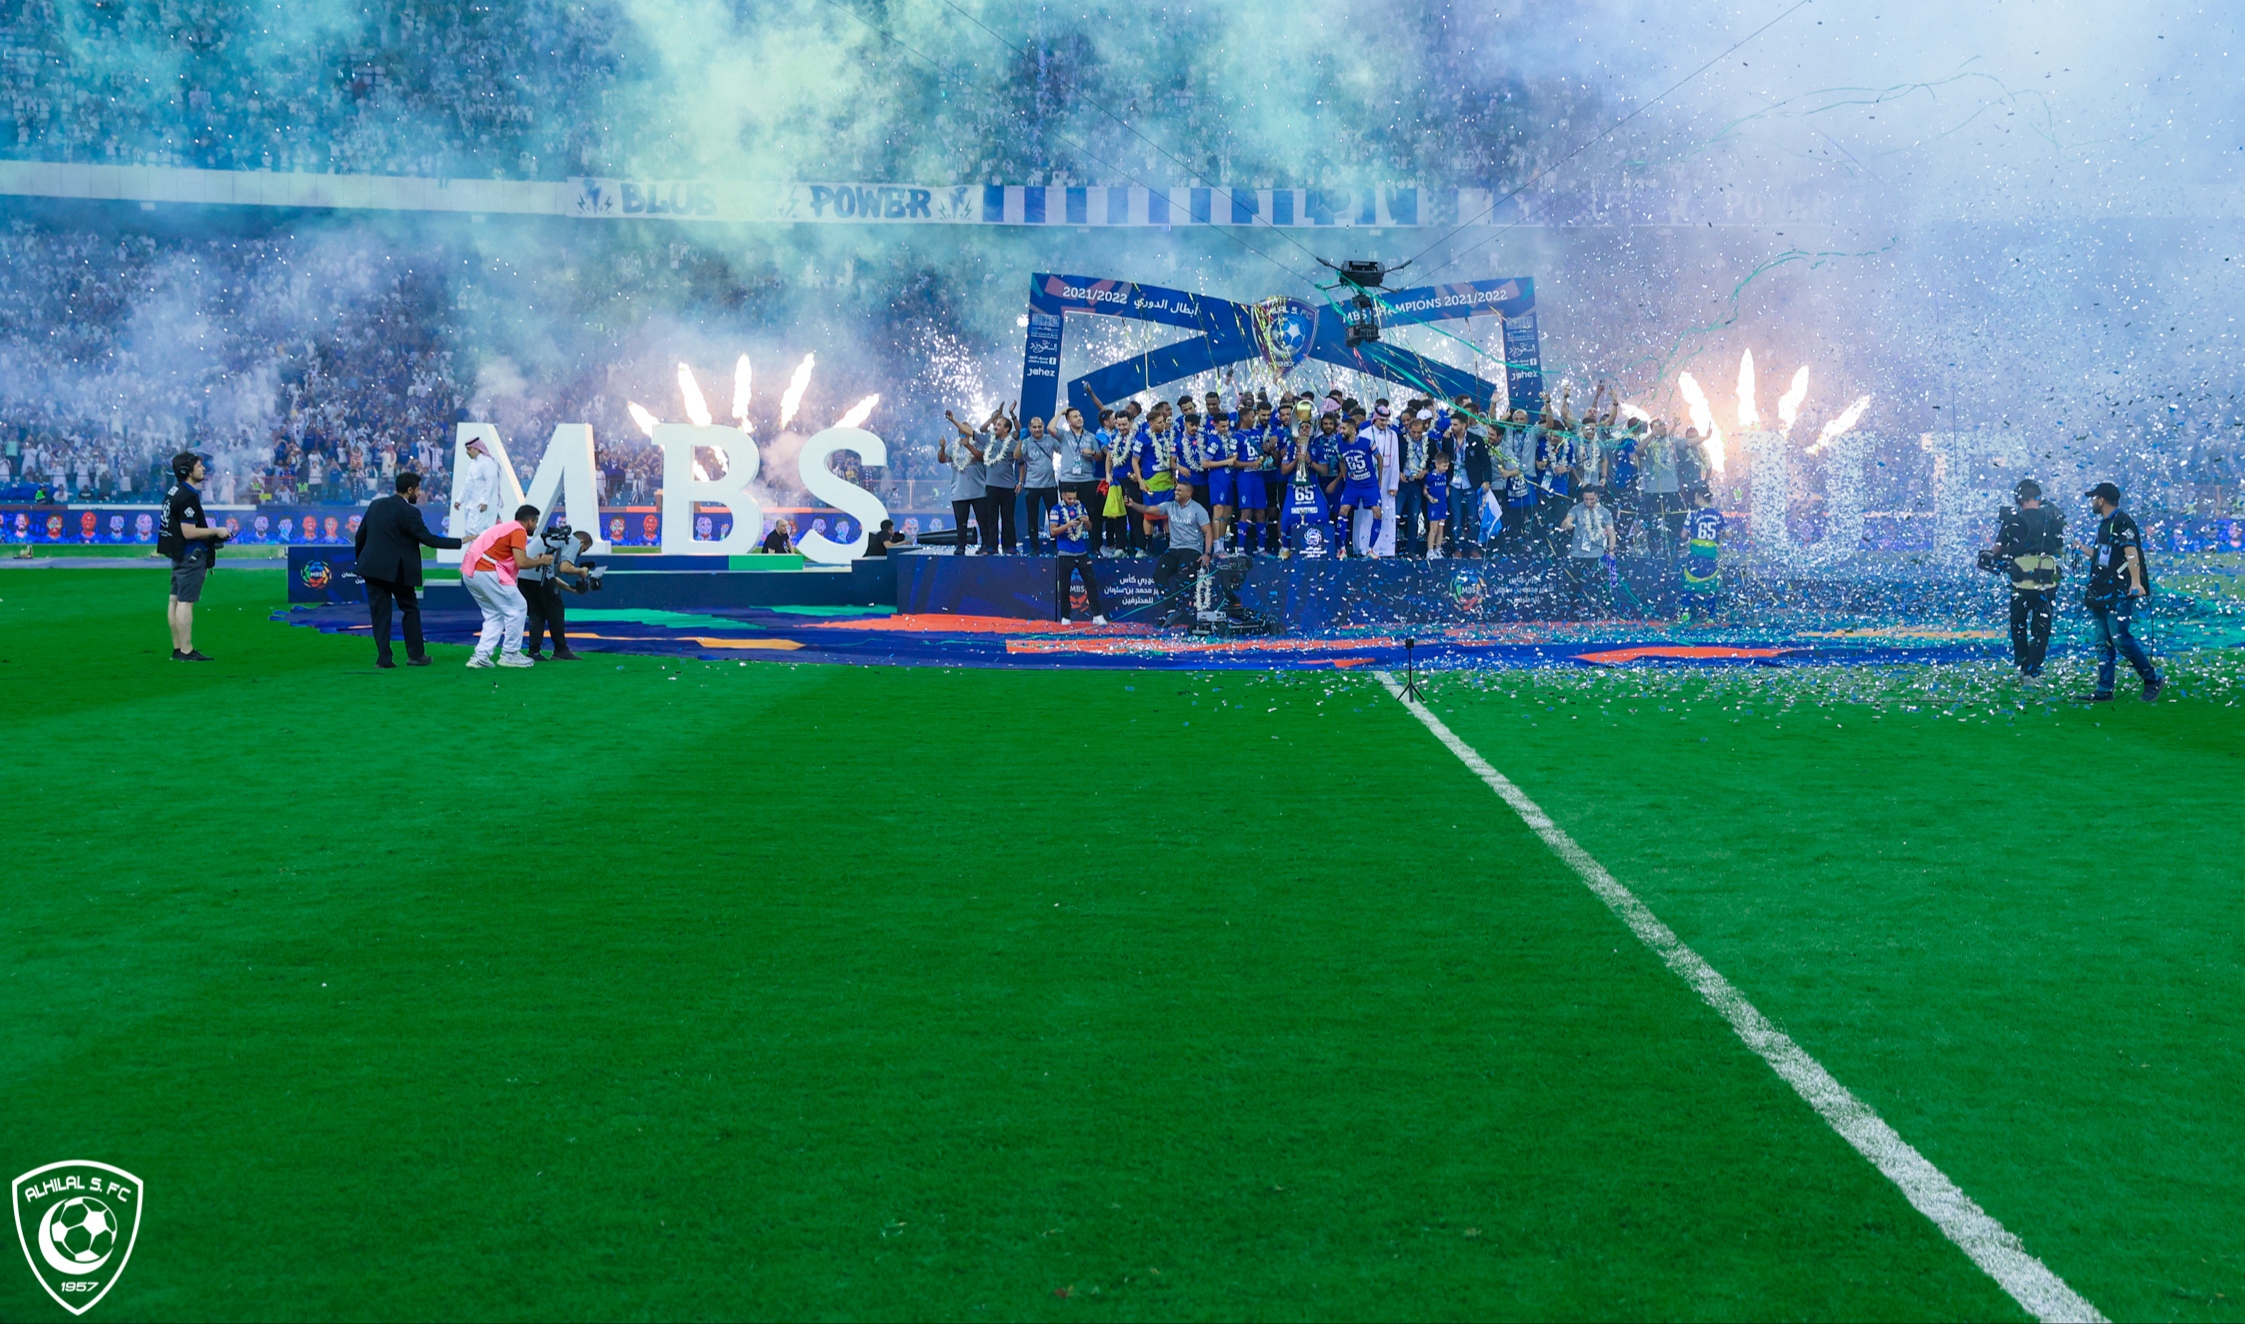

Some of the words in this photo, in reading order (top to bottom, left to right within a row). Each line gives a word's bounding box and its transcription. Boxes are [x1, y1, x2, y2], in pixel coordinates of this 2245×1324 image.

[809, 185, 932, 218] POWER
[1062, 286, 1128, 304] 2021/2022
[1445, 289, 1508, 306] 2021/2022
[1170, 302, 1199, 317] أبطال
[436, 422, 889, 564] MBS
[1295, 485, 1315, 501] 65
[1697, 521, 1717, 540] 65
[1119, 573, 1136, 585] كأس
[1069, 584, 1085, 593] MBS
[1135, 586, 1152, 594] محمد
[1122, 596, 1153, 606] للمحترفين
